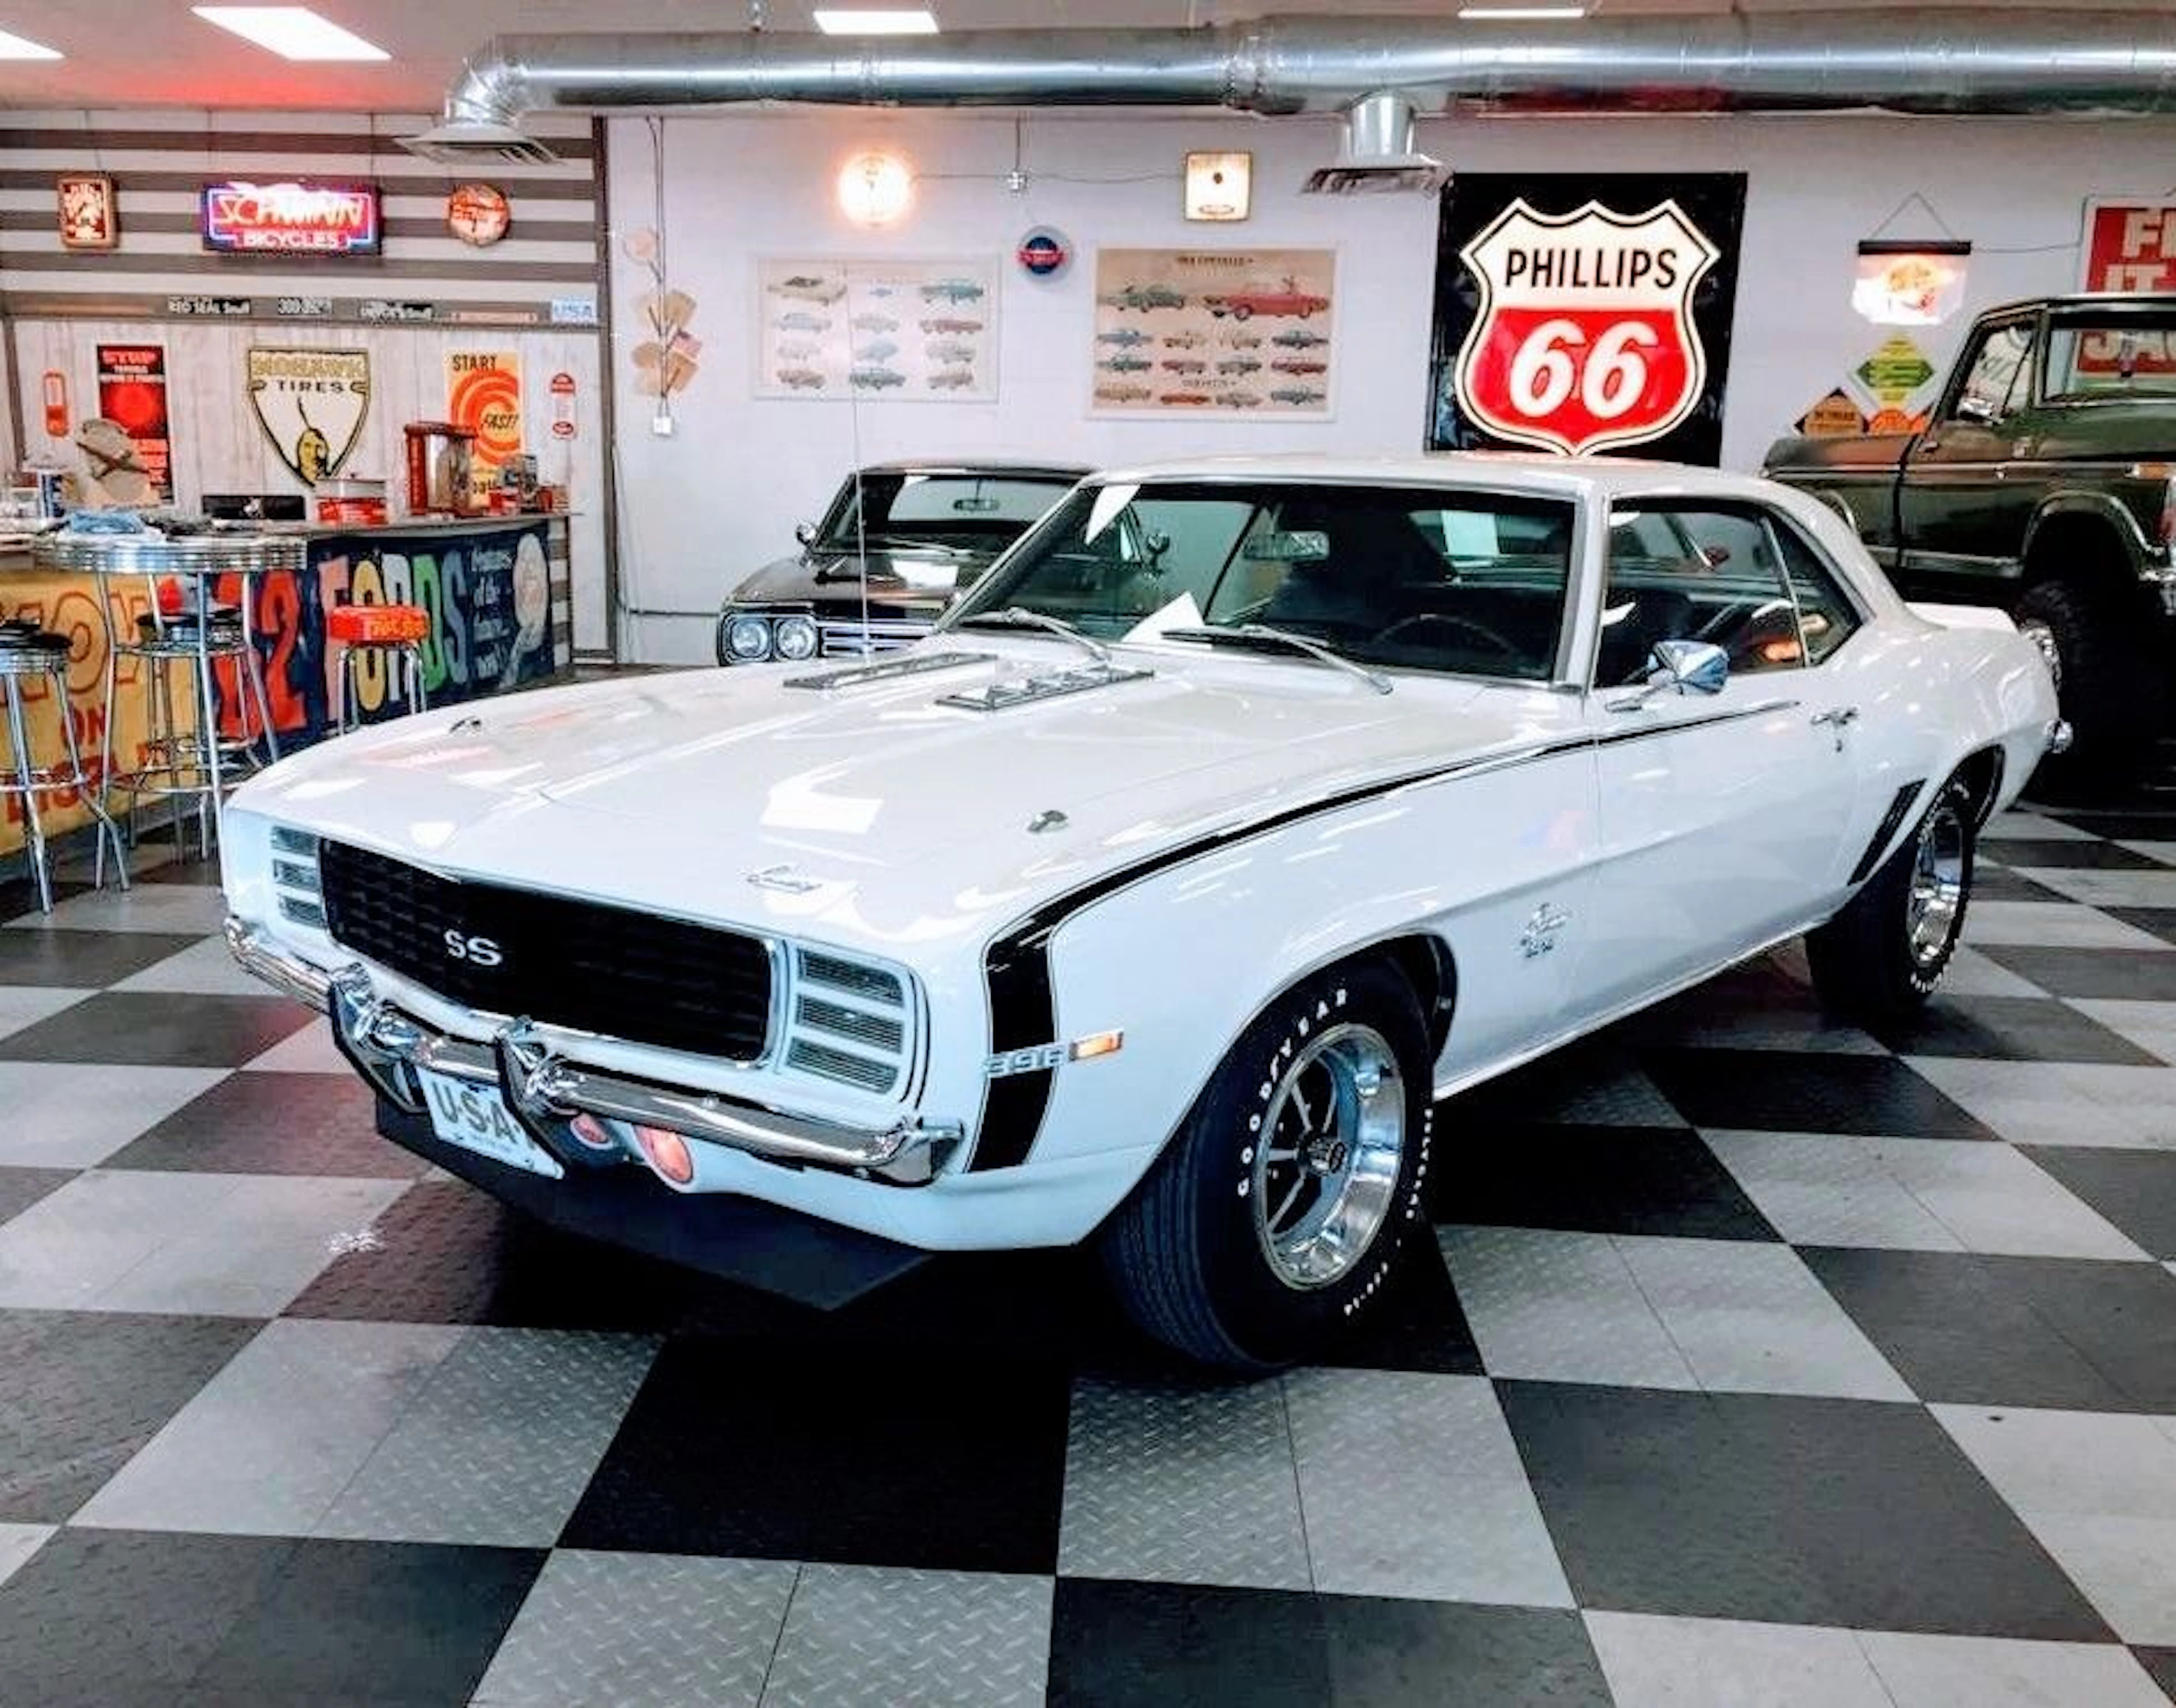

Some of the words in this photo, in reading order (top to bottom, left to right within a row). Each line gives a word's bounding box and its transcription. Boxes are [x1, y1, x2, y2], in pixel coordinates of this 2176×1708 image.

[243, 231, 339, 249] BICYCLES
[1506, 248, 1677, 289] PHILLIPS
[453, 353, 498, 371] START
[1510, 318, 1659, 418] 66
[278, 380, 344, 393] TIRES
[319, 548, 469, 724] FORDS
[444, 928, 503, 966] SS
[986, 1041, 1065, 1079] 396
[1237, 988, 1347, 1197] GOODYEAR
